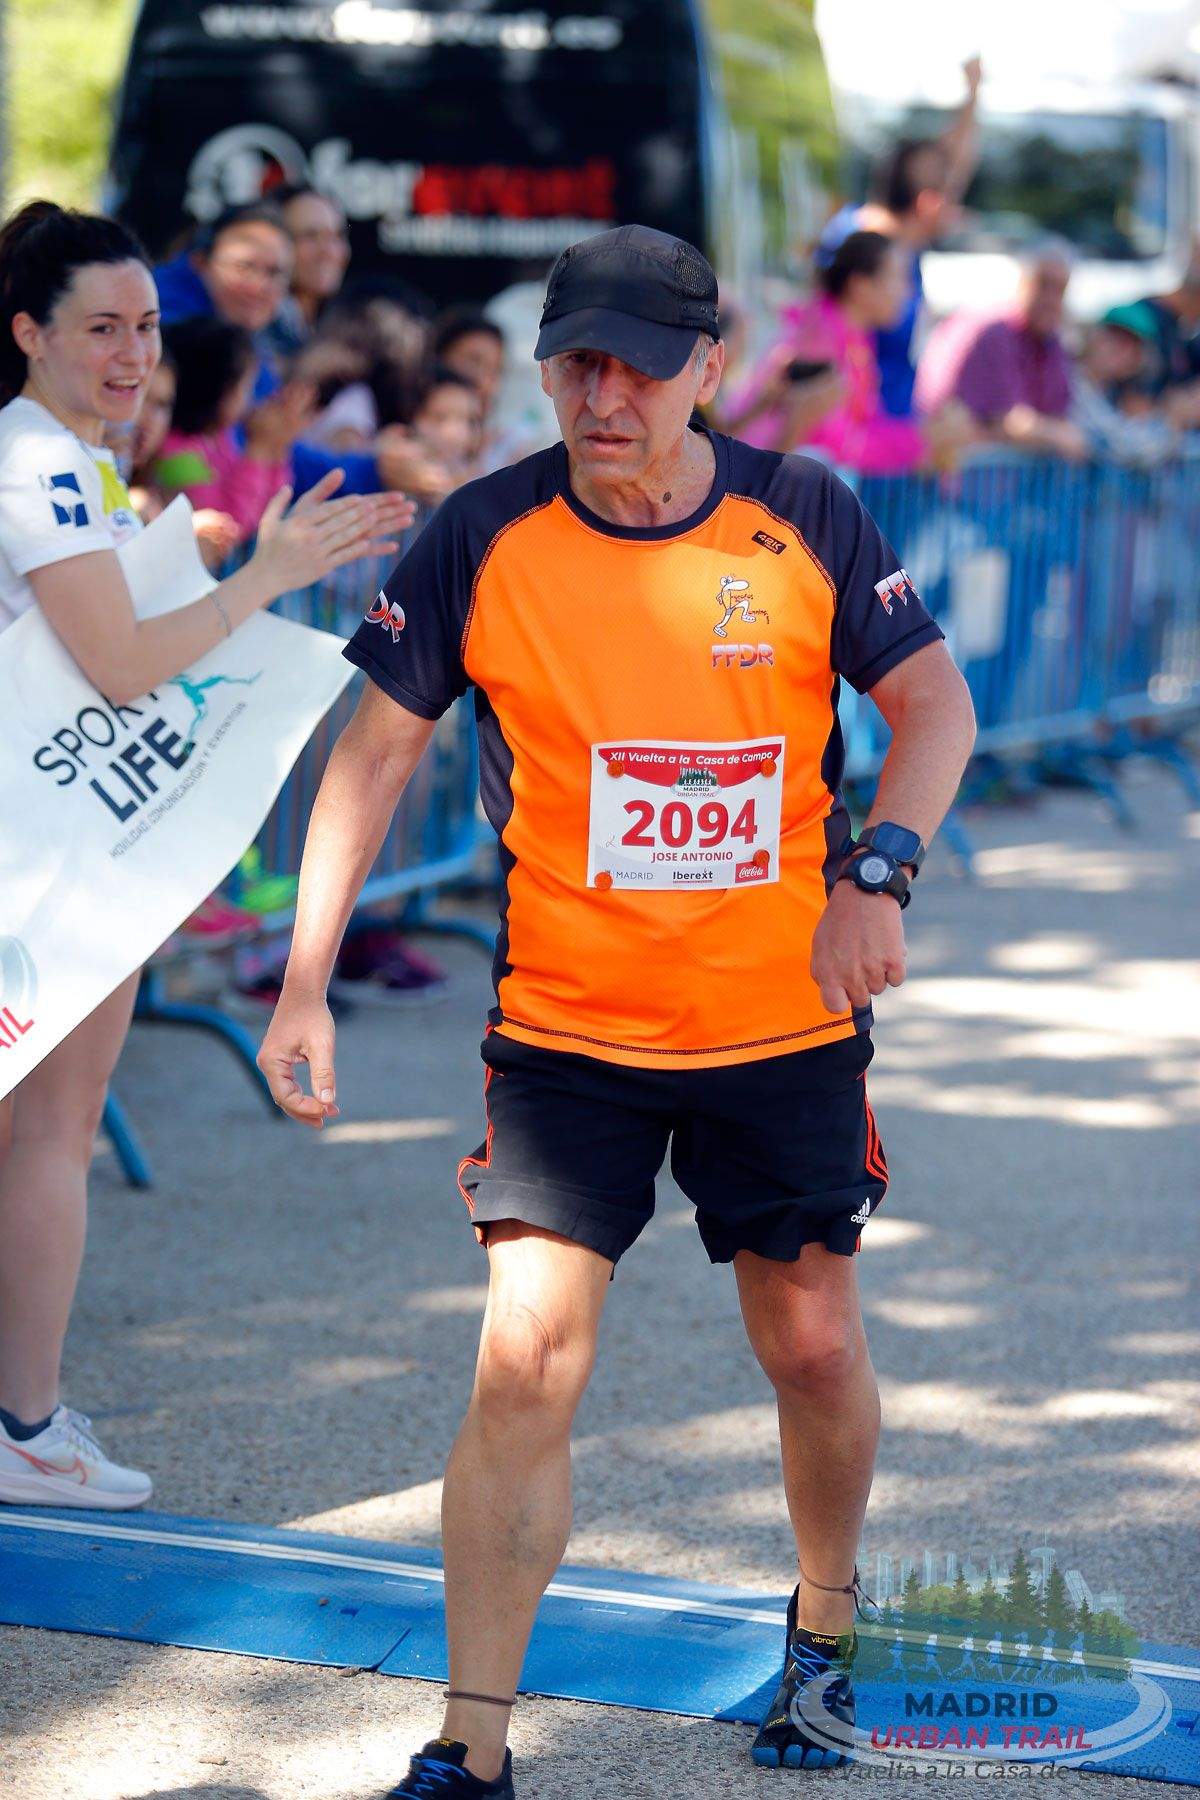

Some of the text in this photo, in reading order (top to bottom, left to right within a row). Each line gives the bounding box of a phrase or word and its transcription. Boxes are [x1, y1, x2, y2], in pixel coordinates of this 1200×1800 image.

[874, 568, 921, 616] FF
[711, 643, 775, 668] FFDR
[32, 691, 161, 787] SPOR
[88, 717, 197, 824] LIFE
[609, 750, 773, 766] XII Vuelta a la Casa de Campo
[620, 798, 759, 849] 2094
[615, 871, 654, 881] MADRID
[672, 868, 714, 881] Iberext
[651, 850, 734, 863] JOSE ANTONIO
